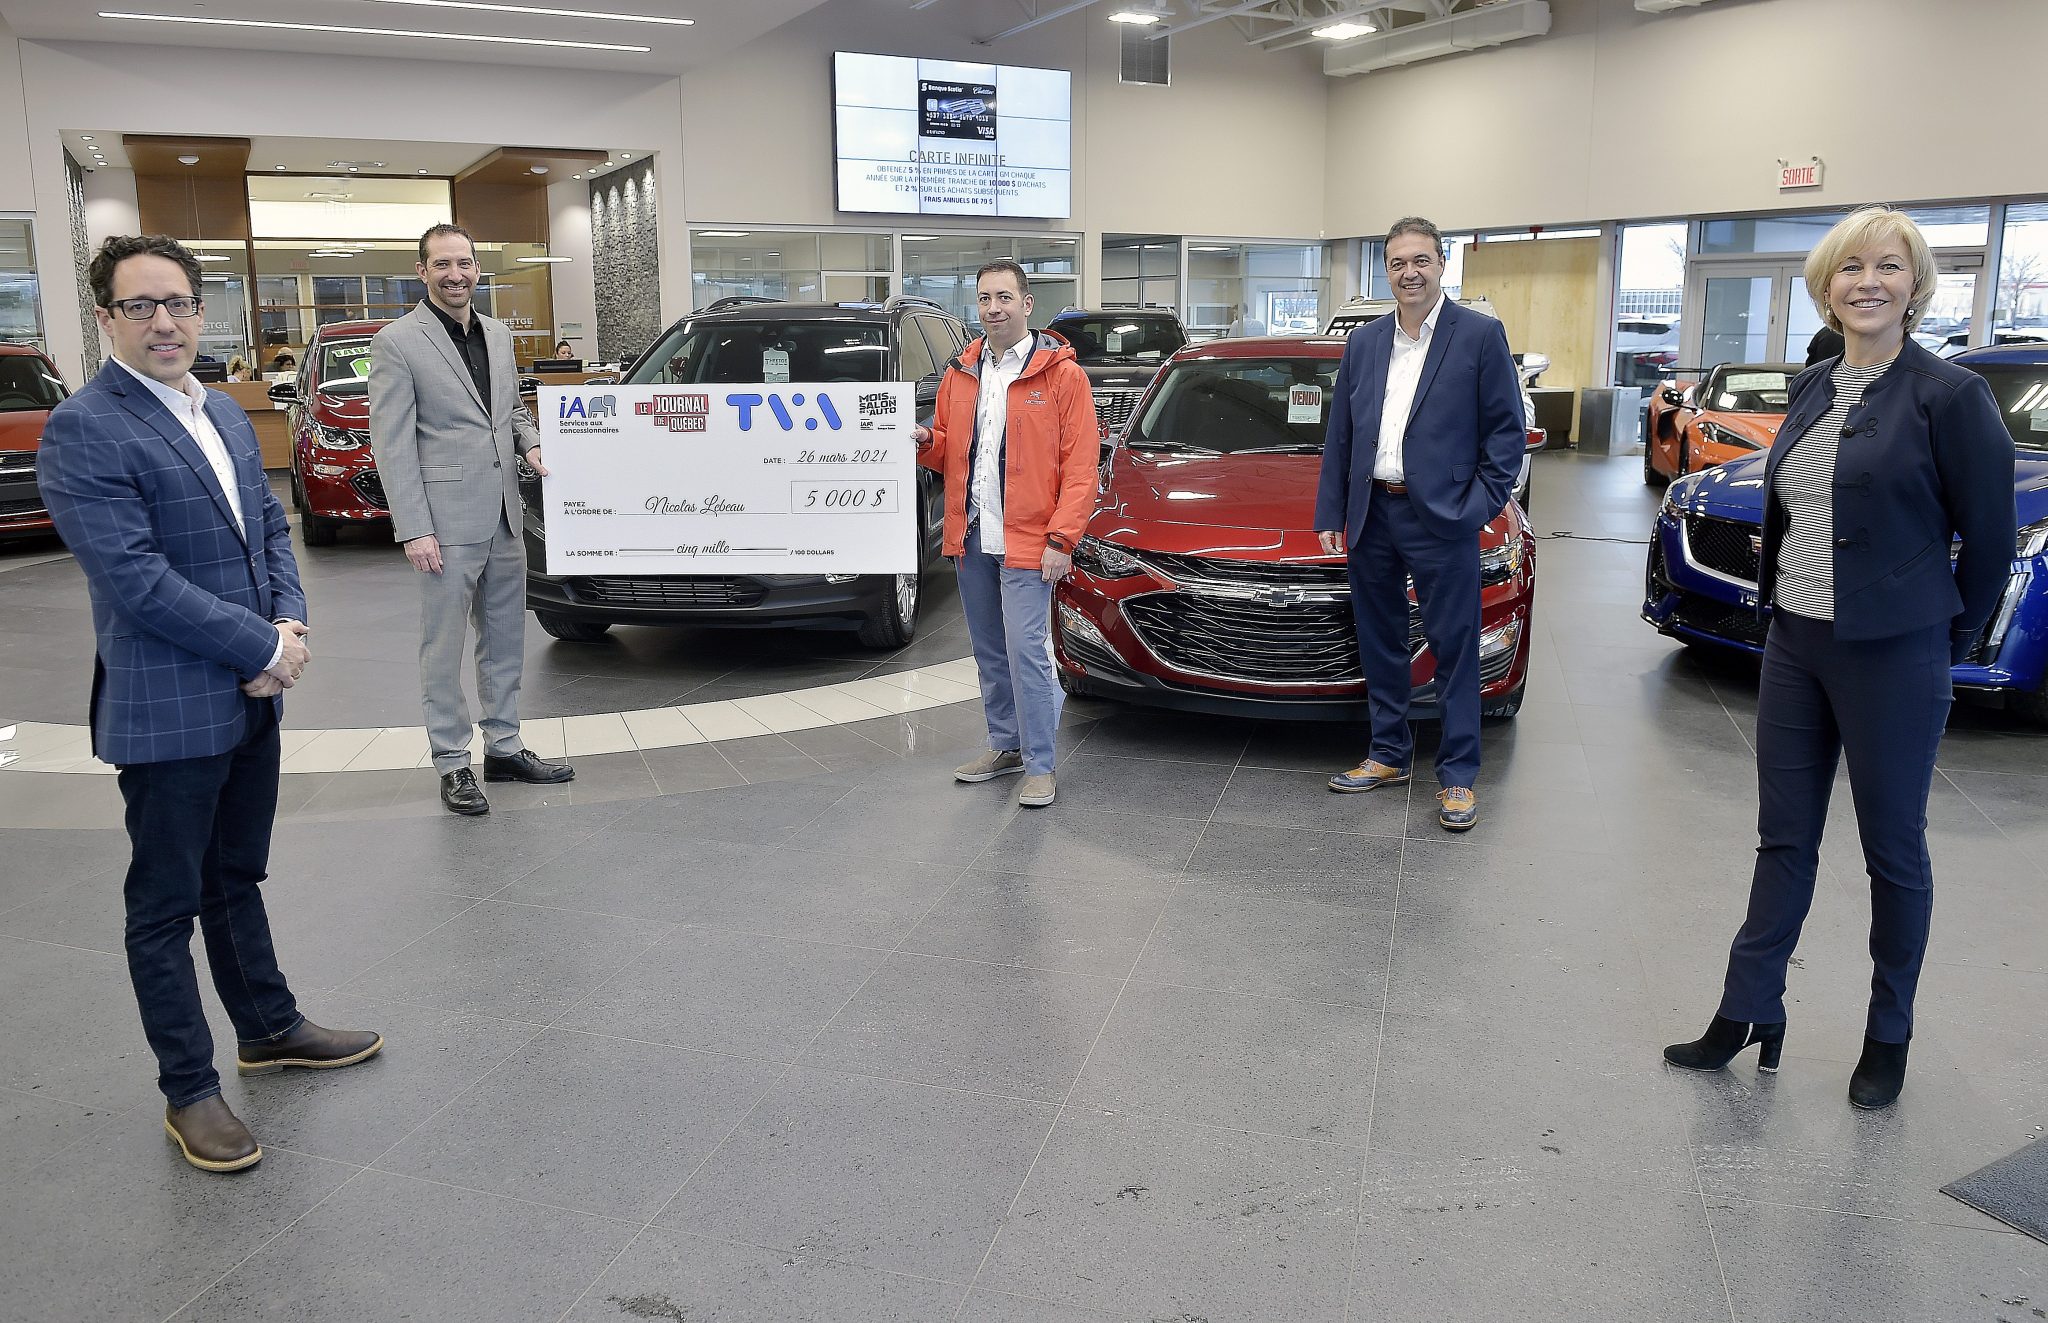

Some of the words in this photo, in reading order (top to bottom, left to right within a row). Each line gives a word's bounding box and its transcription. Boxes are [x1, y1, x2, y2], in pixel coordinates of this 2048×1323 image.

[977, 127, 994, 135] VISA
[909, 150, 951, 164] CARTE
[955, 153, 1006, 167] INFINITE
[877, 165, 907, 174] OBTENEZ
[933, 168, 957, 176] PRIMES
[1010, 171, 1036, 179] CHAQUE
[1782, 167, 1815, 185] SORTIE
[914, 176, 946, 184] PREMIÈRE
[948, 177, 978, 186] TRANCHE
[1017, 181, 1047, 189] D'ACHATS
[905, 184, 910, 192] 2
[973, 187, 1019, 196] SUBSÉQUENTS
[923, 195, 942, 203] FRAIS
[942, 196, 970, 204] ANNUELS
[501, 317, 533, 325] EETGE
[858, 392, 889, 402] MOIS
[1291, 391, 1320, 406] VENDU
[639, 403, 648, 414] LE
[655, 395, 707, 413] JOURNAL
[859, 400, 897, 410] SALON
[726, 393, 842, 431] TVA
[657, 416, 665, 425] DE
[670, 416, 704, 431] QUÉBEC
[797, 450, 816, 463] 26
[818, 452, 848, 463] mars
[850, 449, 888, 462] 2021
[804, 490, 819, 508] 5
[825, 489, 866, 507] 000
[870, 487, 886, 508] $
[644, 496, 698, 515] Nicolas
[699, 494, 746, 518] Lebeau
[676, 542, 698, 559] cinq
[701, 540, 730, 554] mille
